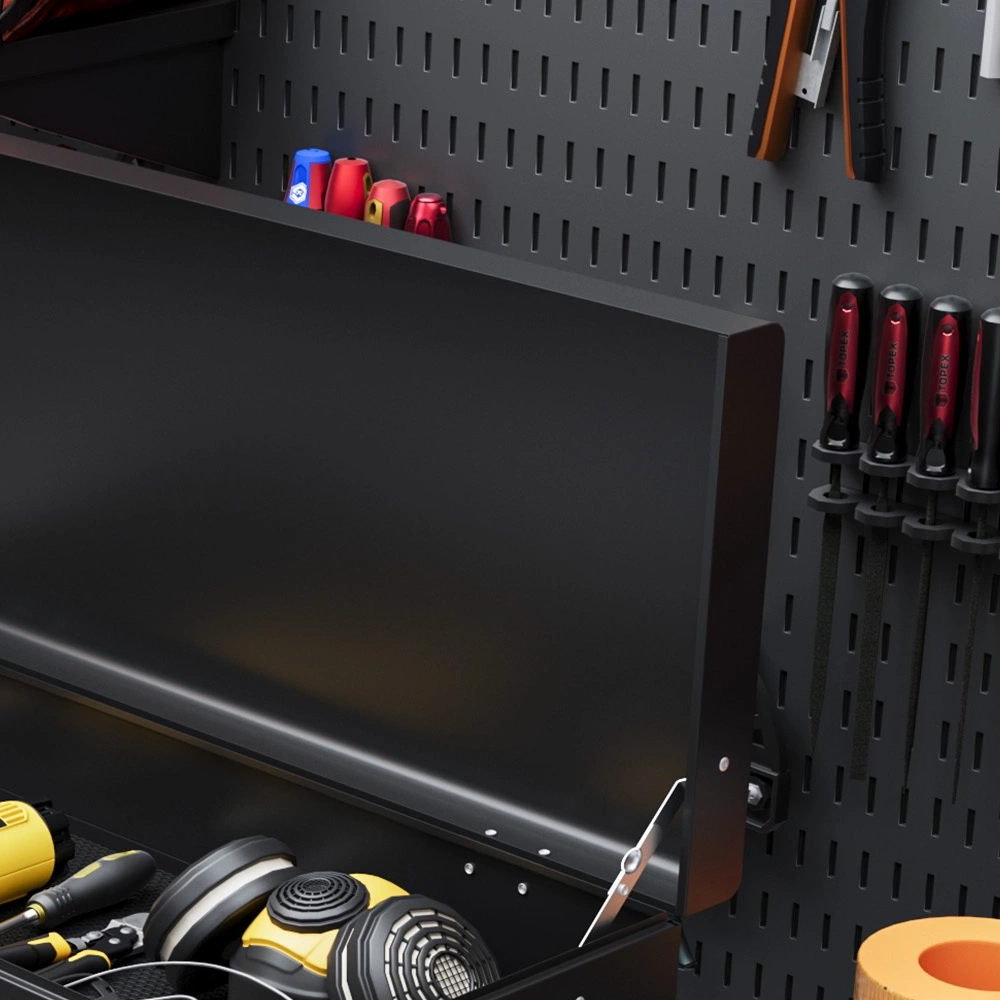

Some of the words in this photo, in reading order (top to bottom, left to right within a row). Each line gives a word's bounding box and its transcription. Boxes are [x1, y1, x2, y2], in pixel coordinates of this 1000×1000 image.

[839, 330, 849, 366] TOPEX
[888, 342, 898, 378] TOPEX
[939, 354, 950, 391] TOPEX
